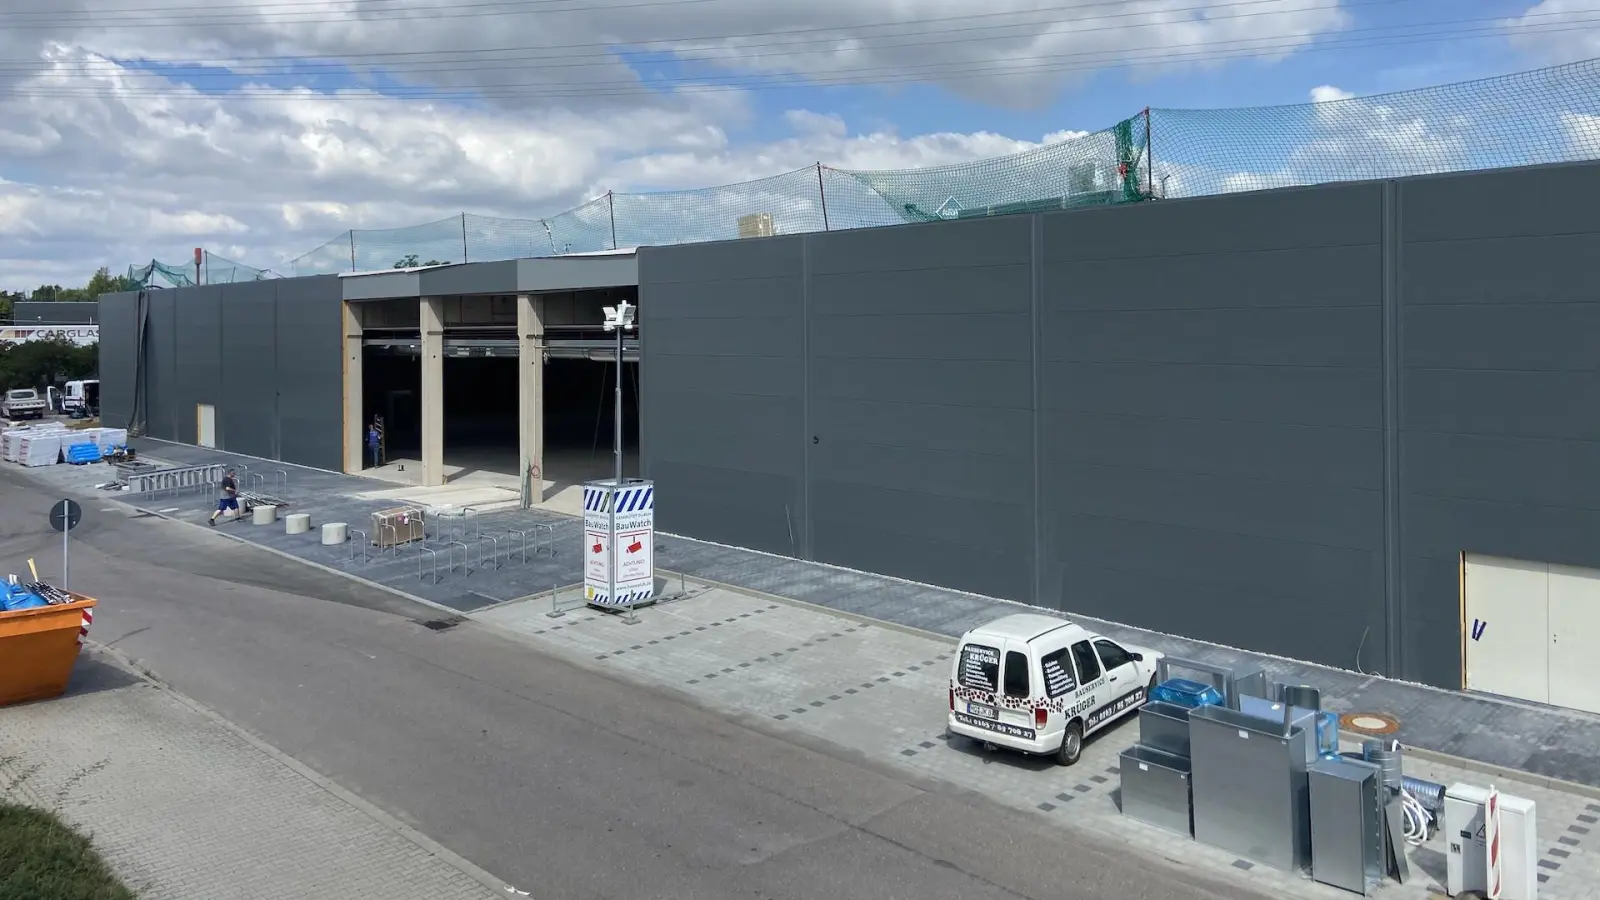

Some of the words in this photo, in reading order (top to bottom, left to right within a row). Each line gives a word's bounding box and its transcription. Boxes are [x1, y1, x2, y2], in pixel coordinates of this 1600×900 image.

[585, 519, 609, 530] BauWatch
[616, 519, 651, 530] BauWatch
[965, 646, 994, 656] BAUSERVICE
[970, 653, 999, 665] KRÜGER
[1075, 677, 1105, 698] BAUSERVICE
[1064, 695, 1096, 720] KRÜGER
[1023, 730, 1033, 739] 27
